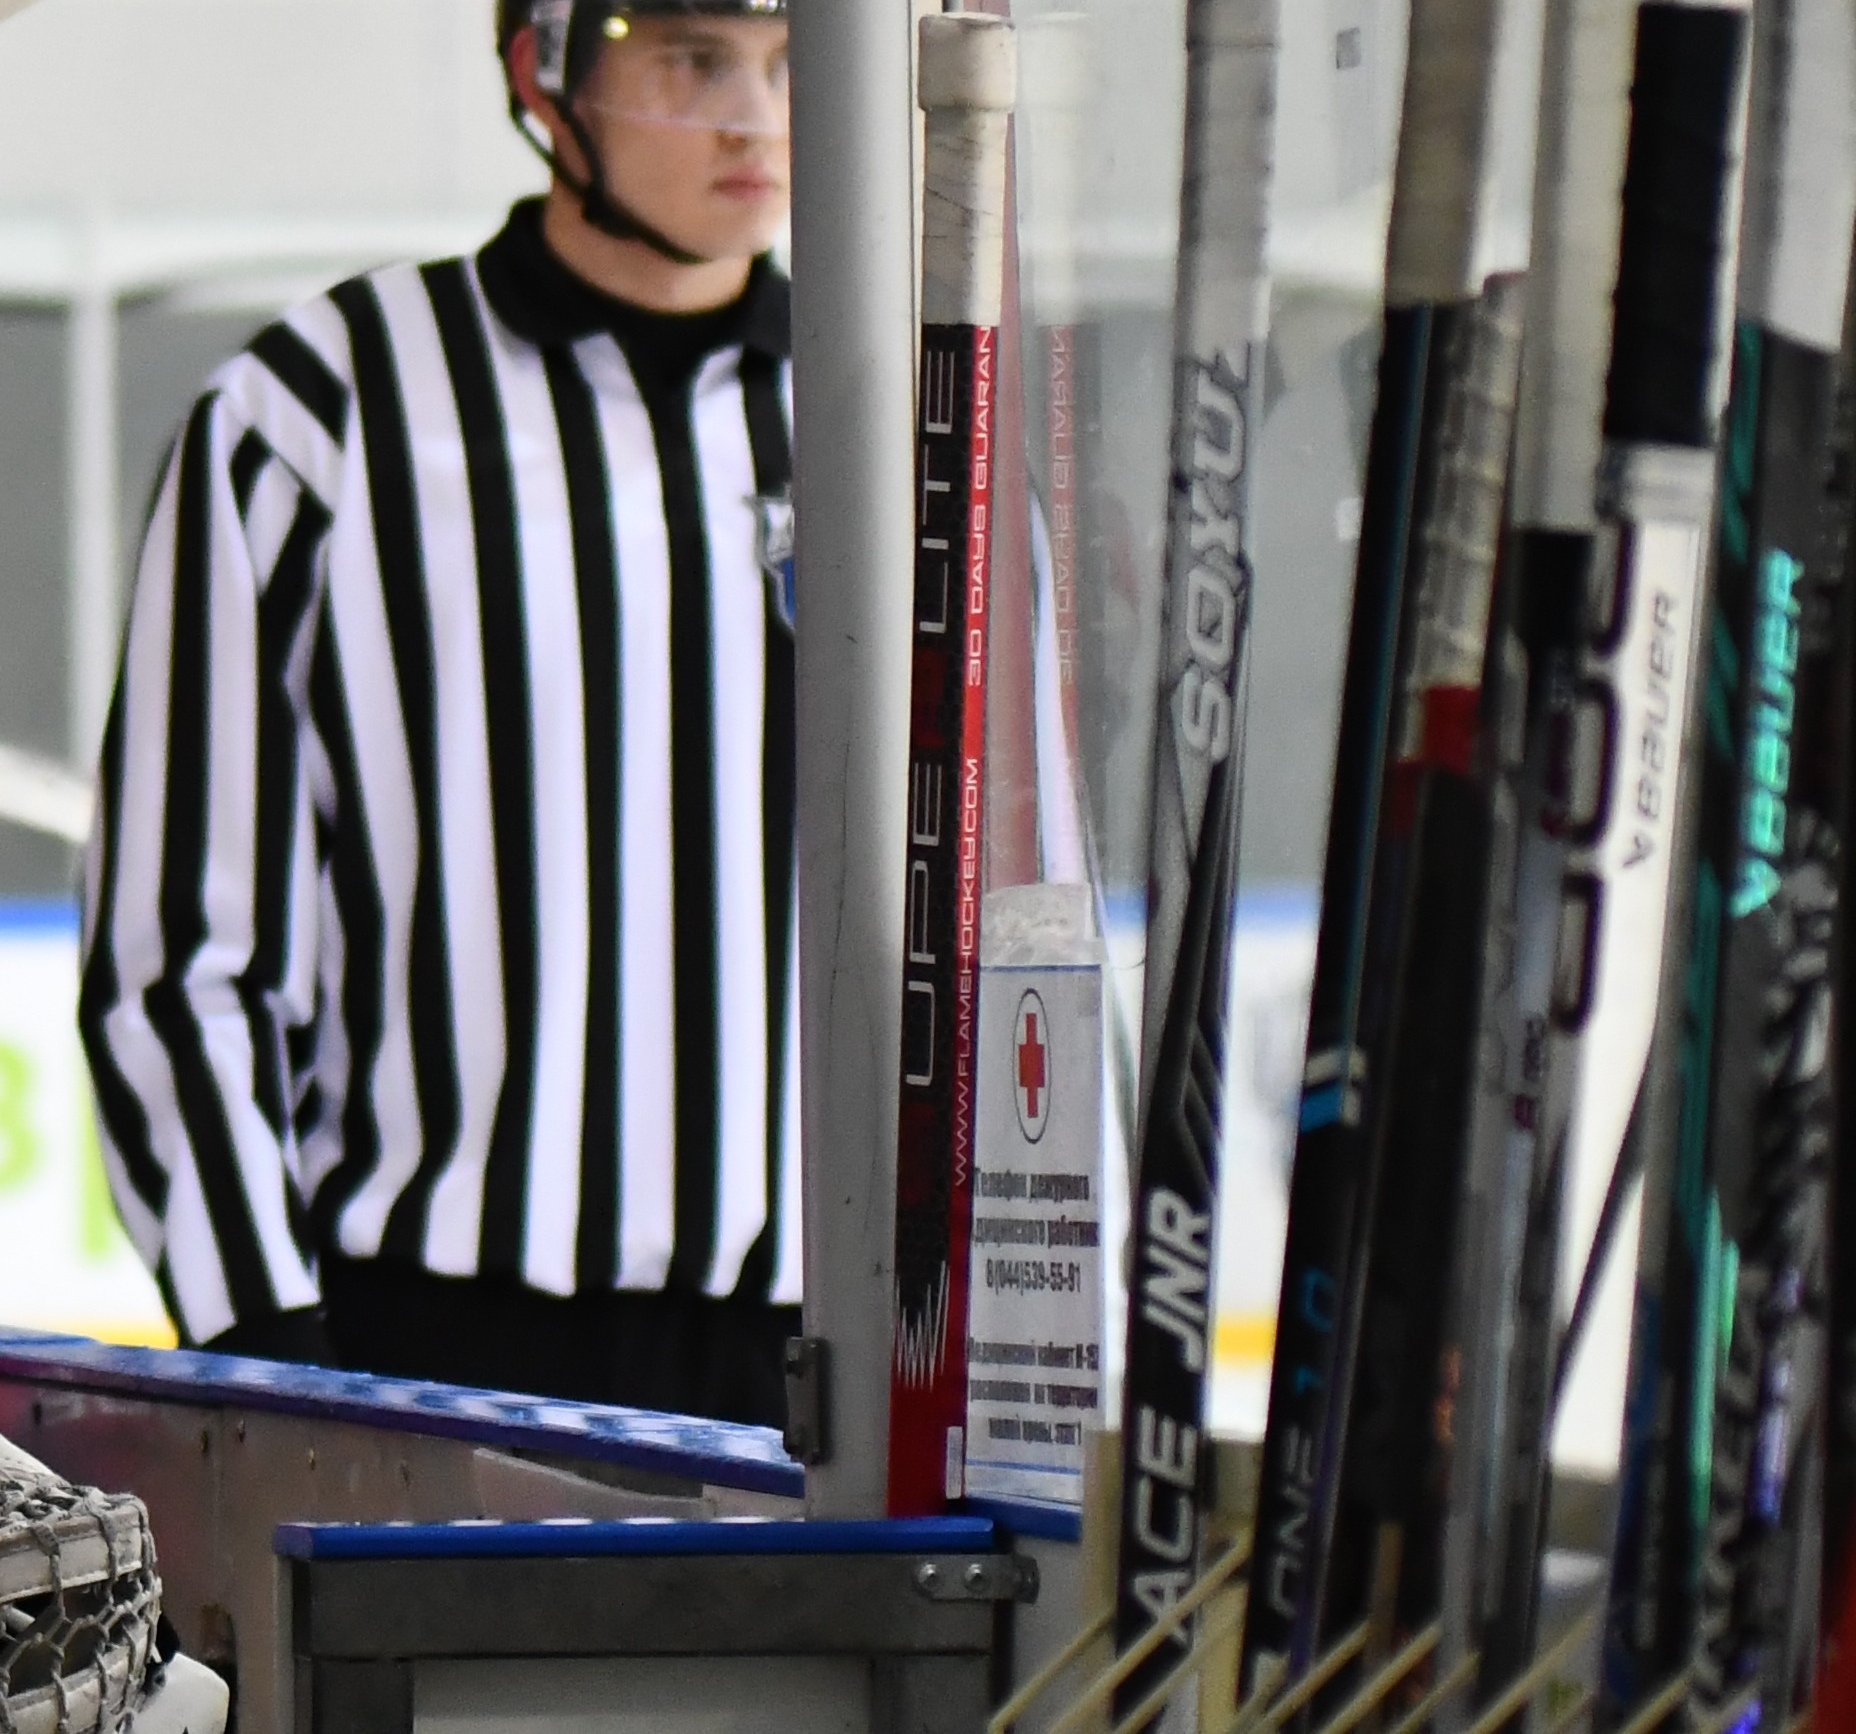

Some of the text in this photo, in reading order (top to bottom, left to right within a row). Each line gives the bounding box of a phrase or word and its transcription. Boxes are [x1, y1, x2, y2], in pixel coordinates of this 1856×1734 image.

[918, 350, 955, 634] LITE
[970, 503, 986, 615] DAYS
[954, 757, 980, 1187] WWW.FLAMEHOCKEY.COM
[1133, 1186, 1210, 1650] ACE JNR
